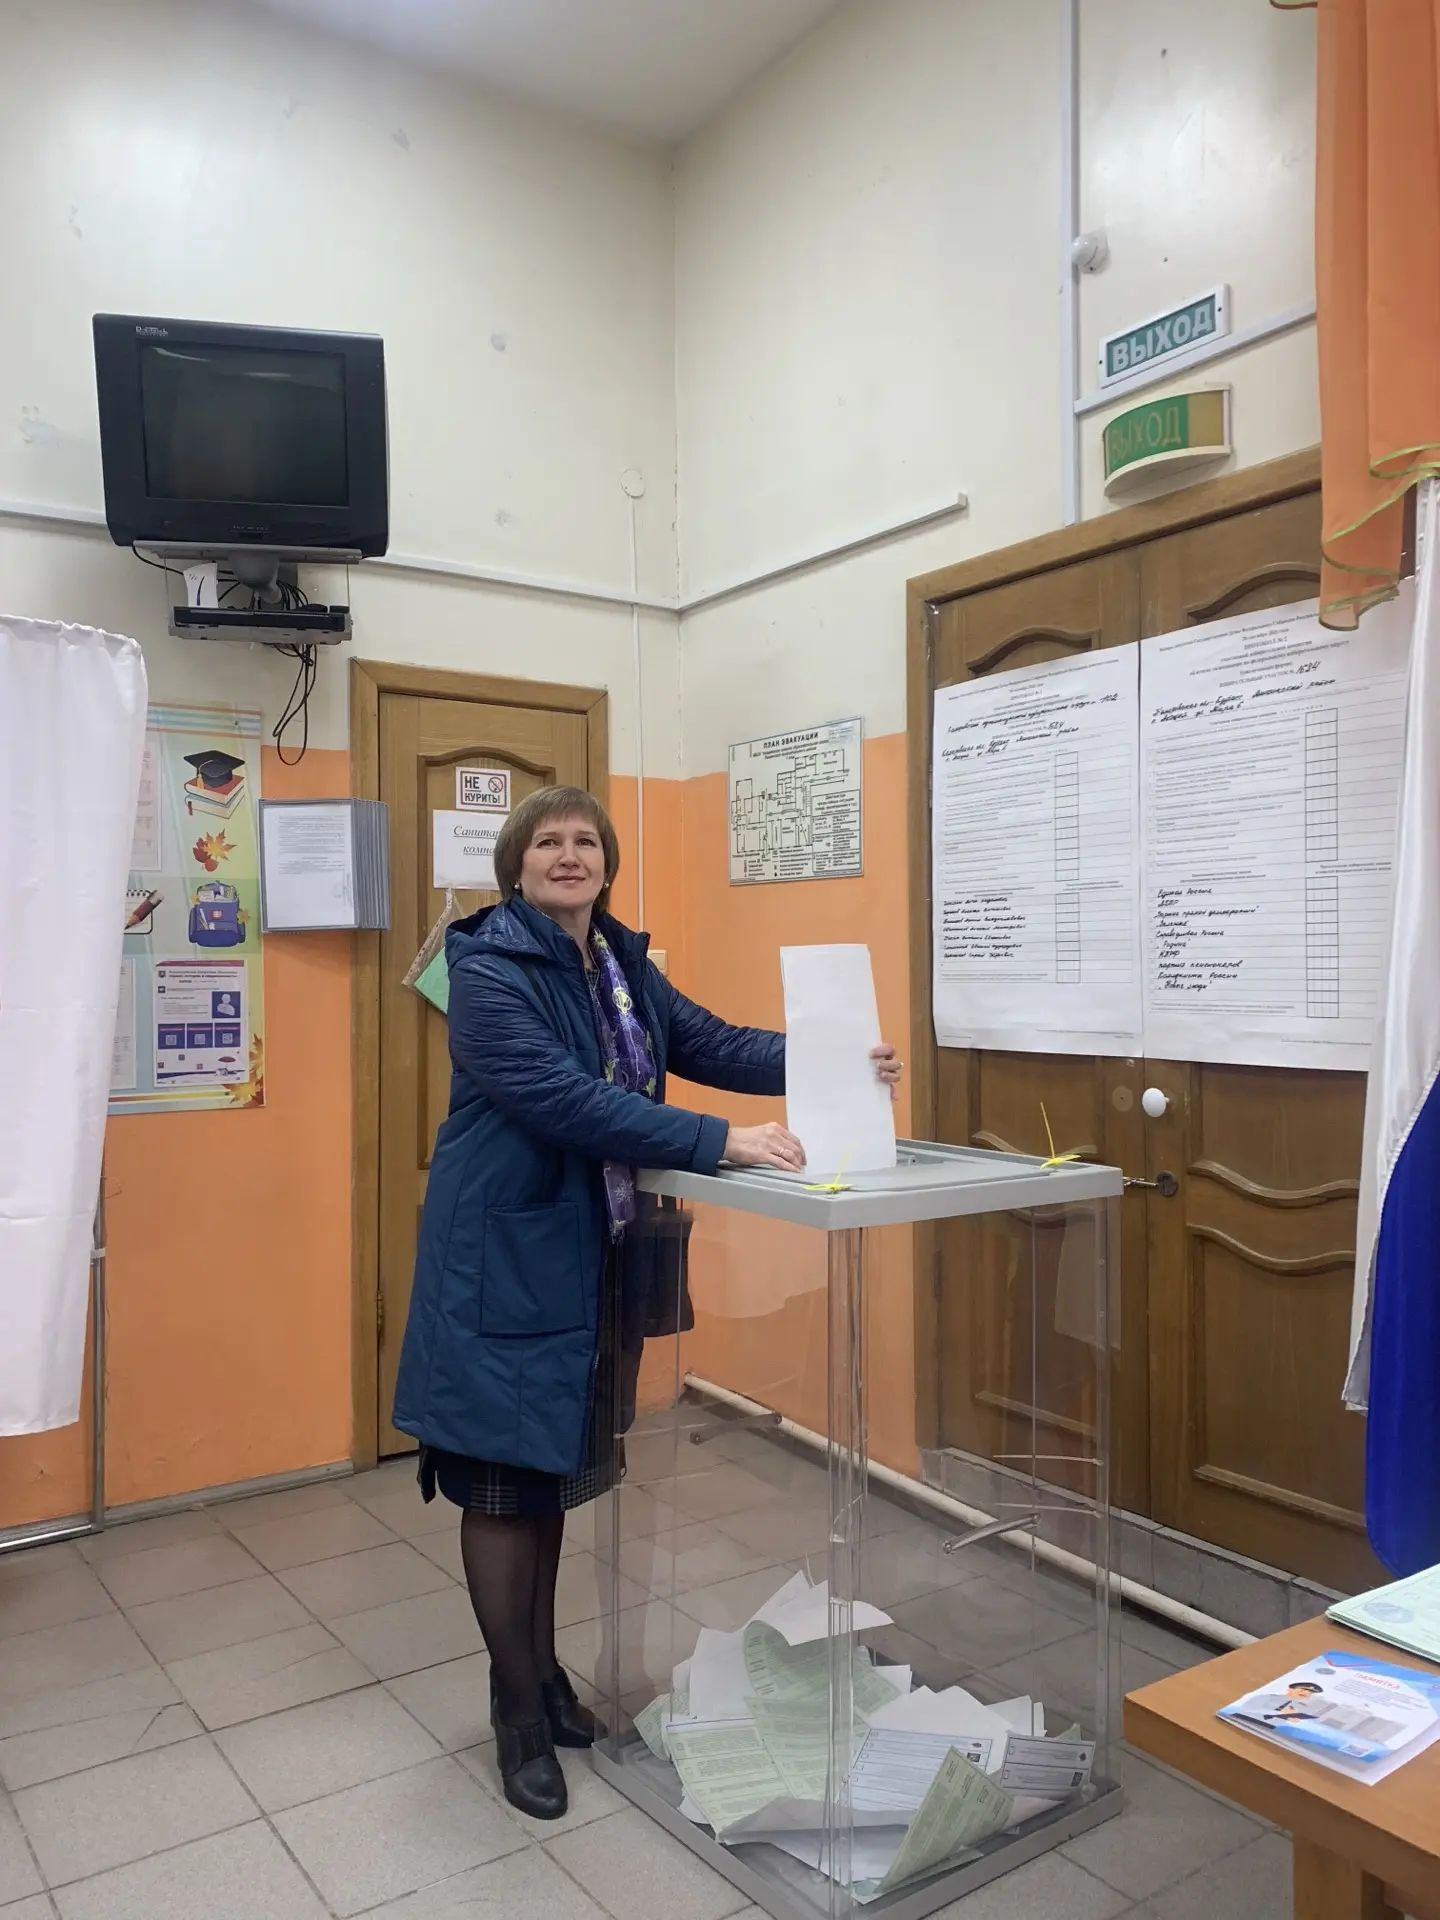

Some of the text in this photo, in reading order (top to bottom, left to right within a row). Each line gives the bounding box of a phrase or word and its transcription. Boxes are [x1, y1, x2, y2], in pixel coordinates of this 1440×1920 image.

[1112, 303, 1213, 372] ВЫХОД
[1111, 406, 1181, 463] ВЫХОД
[763, 740, 781, 750] ПЛАН
[781, 731, 819, 747] ЭВАКУАЦИИ
[464, 775, 480, 790] НЕ
[464, 792, 501, 804] КУРИТЬ!
